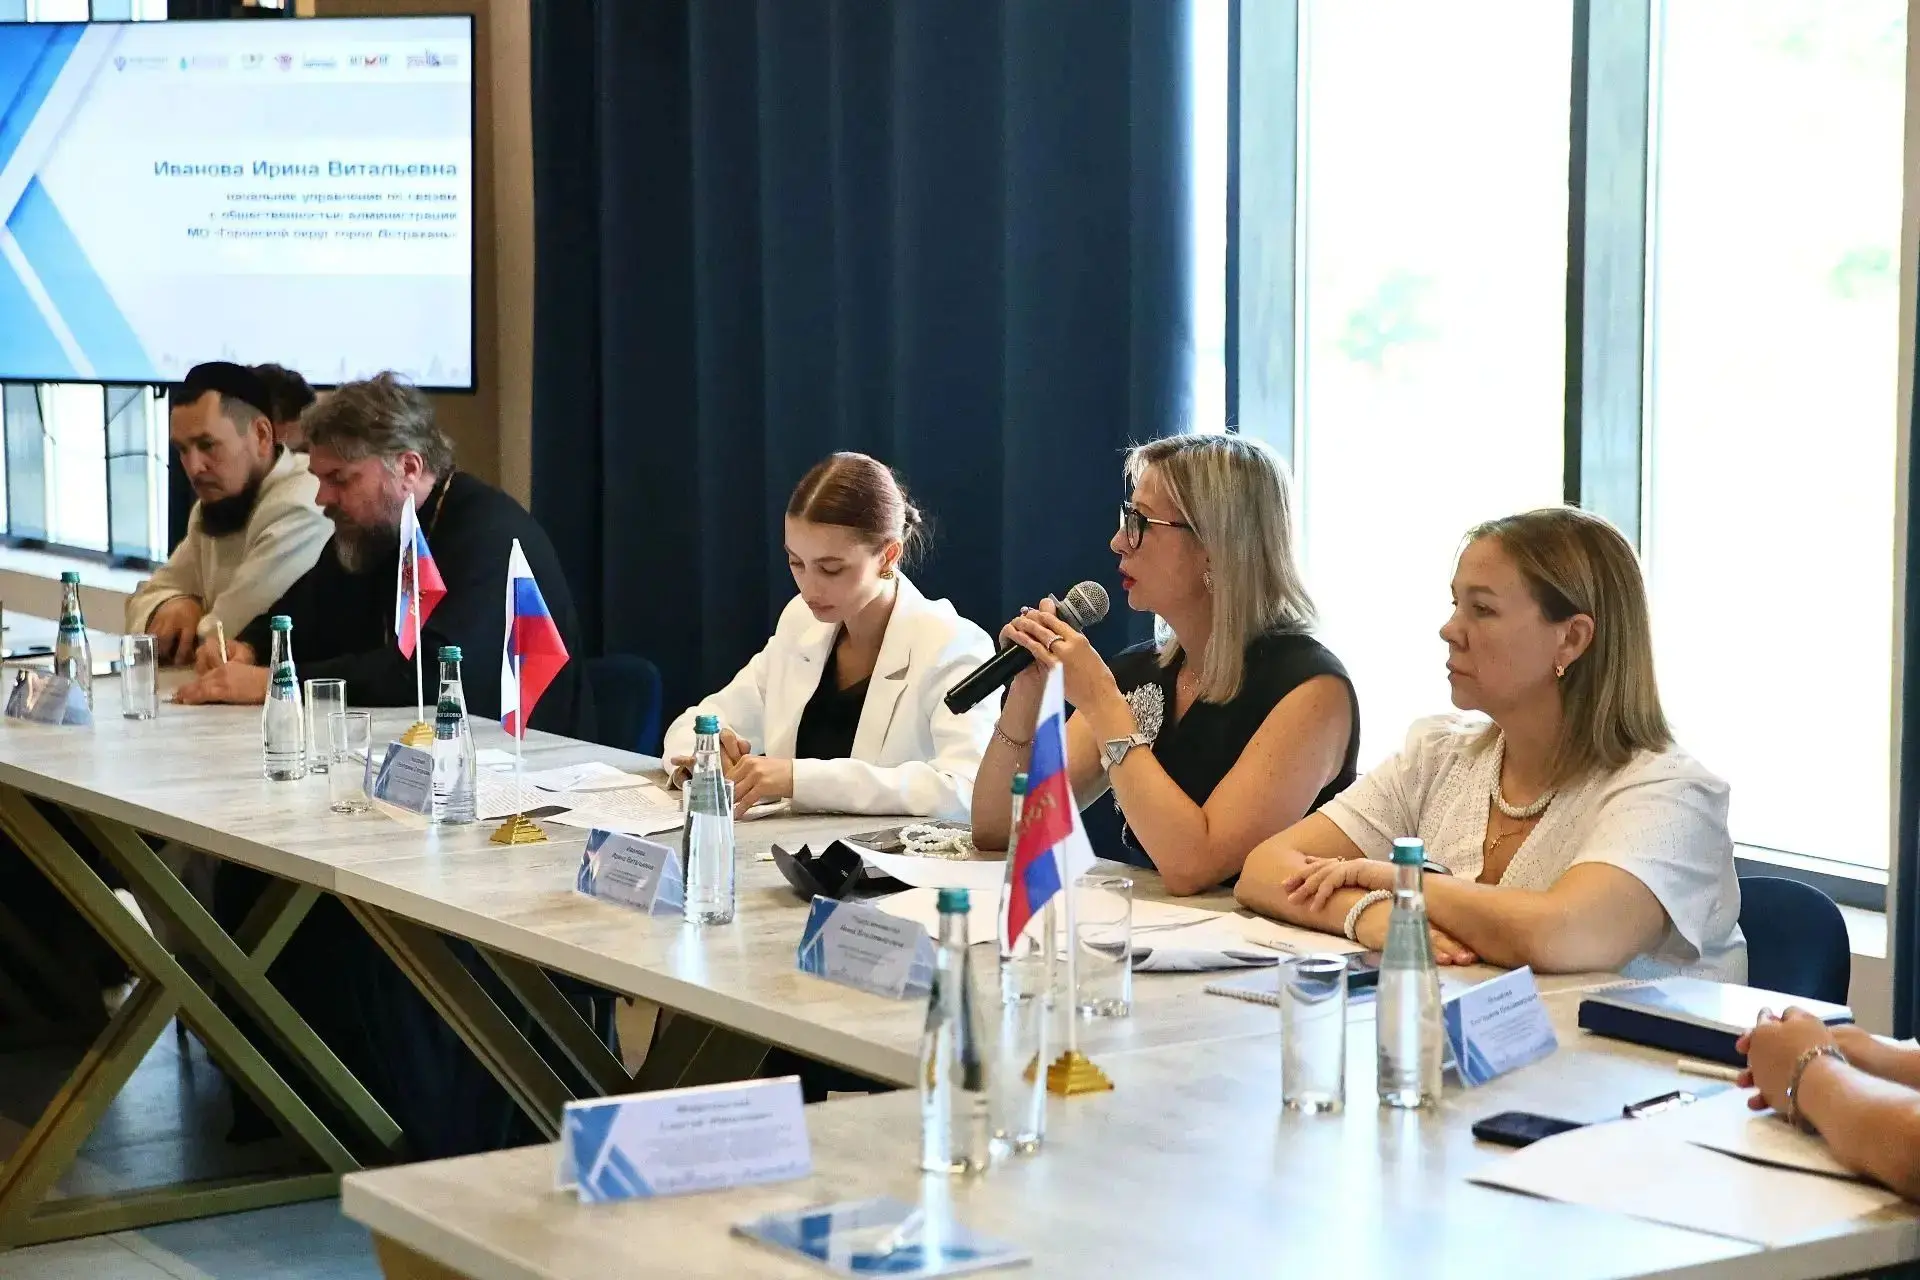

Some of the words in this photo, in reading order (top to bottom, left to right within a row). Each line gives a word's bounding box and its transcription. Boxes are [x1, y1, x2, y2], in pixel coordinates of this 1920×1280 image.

[153, 160, 244, 177] Иванова
[252, 160, 320, 180] Ирина
[328, 160, 458, 177] Витальевна
